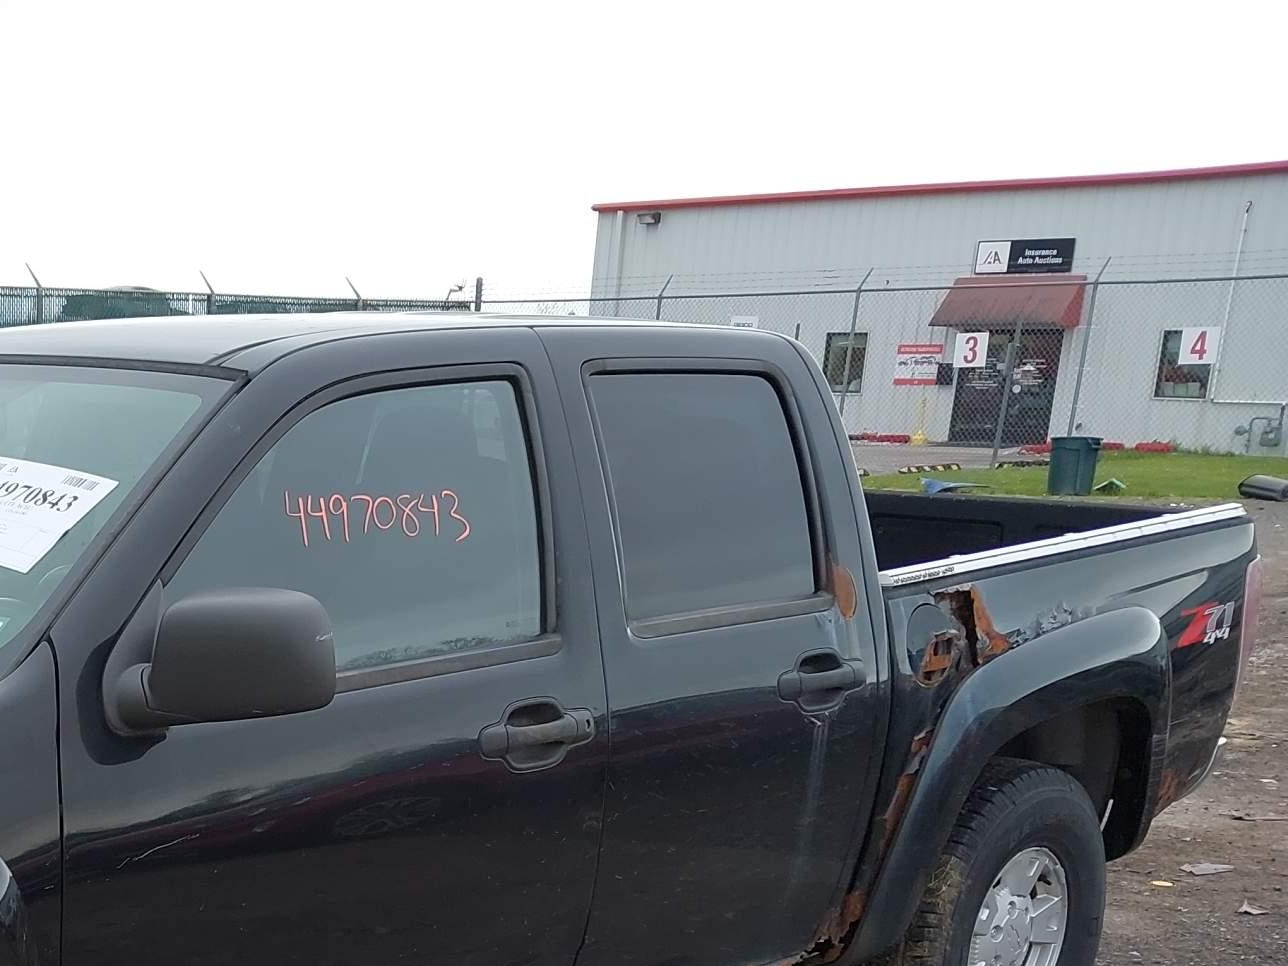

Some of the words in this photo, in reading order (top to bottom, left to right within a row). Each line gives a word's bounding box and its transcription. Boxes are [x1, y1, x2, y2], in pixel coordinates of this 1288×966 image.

[1034, 256, 1063, 264] Auctions
[963, 335, 978, 364] 3
[1190, 331, 1207, 360] 4
[284, 489, 472, 547] 44970843
